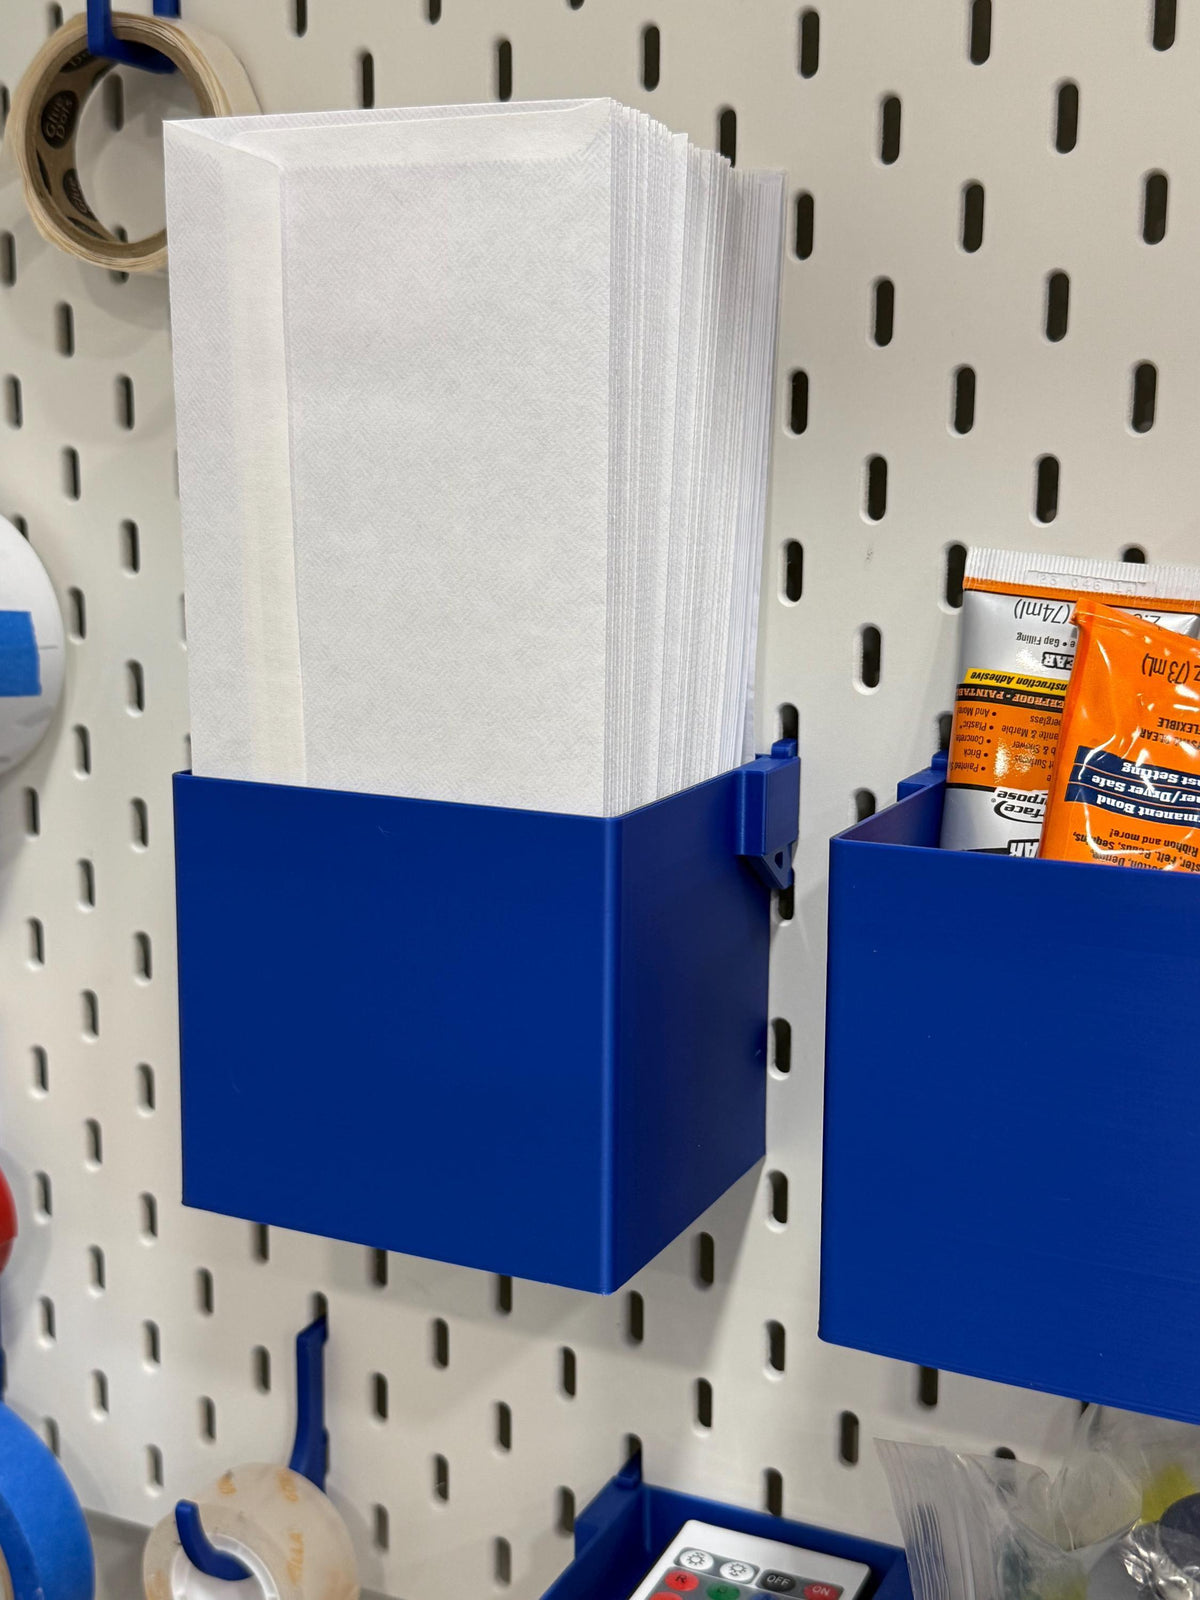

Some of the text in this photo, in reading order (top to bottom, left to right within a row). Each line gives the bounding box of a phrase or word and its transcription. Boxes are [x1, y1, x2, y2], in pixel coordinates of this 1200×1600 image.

[1014, 599, 1070, 625] (74ml)
[1016, 633, 1042, 646] Filling
[1044, 637, 1060, 649] Gap
[1141, 653, 1168, 677] mL)
[969, 672, 1014, 685] Adhesive
[1168, 661, 1190, 684] (73
[975, 707, 990, 717] And
[1002, 725, 1029, 738] Marble
[1030, 730, 1037, 740] &
[964, 749, 981, 759] Brick
[1043, 746, 1049, 755] &
[1091, 775, 1125, 794] Safe
[1096, 794, 1135, 813] Bond
[1109, 829, 1198, 858] Ribbon and more!
[675, 1575, 688, 1584] R
[766, 1575, 831, 1597] OFF ON
